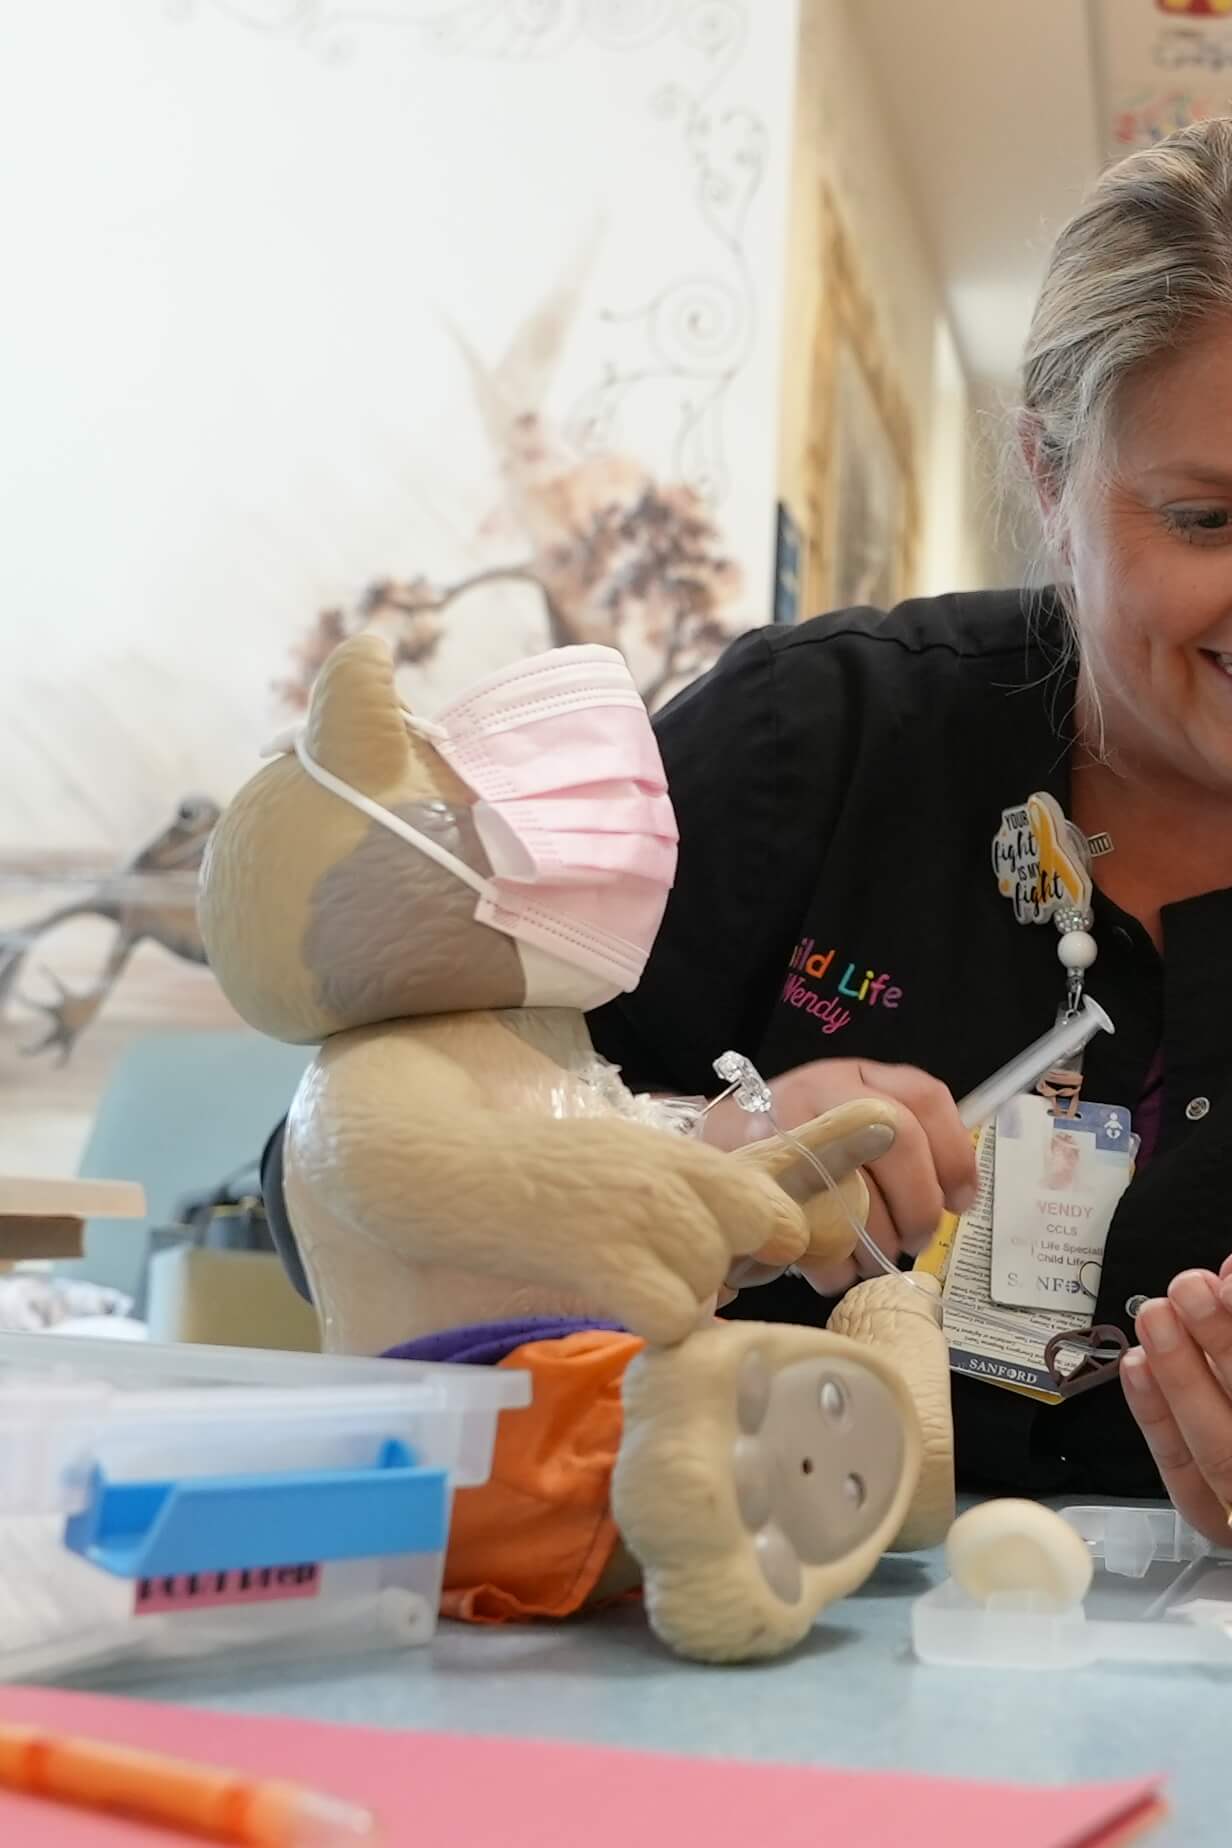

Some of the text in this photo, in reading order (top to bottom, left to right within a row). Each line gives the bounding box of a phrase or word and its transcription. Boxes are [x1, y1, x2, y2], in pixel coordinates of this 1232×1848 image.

[1005, 810, 1030, 831] YOUR
[994, 831, 1037, 873] fight
[1018, 862, 1041, 881] IS MY
[1016, 870, 1064, 918] fight
[838, 962, 903, 1009] Life
[1046, 1223, 1078, 1237] CCLS
[968, 1358, 1038, 1385] SANFORD
